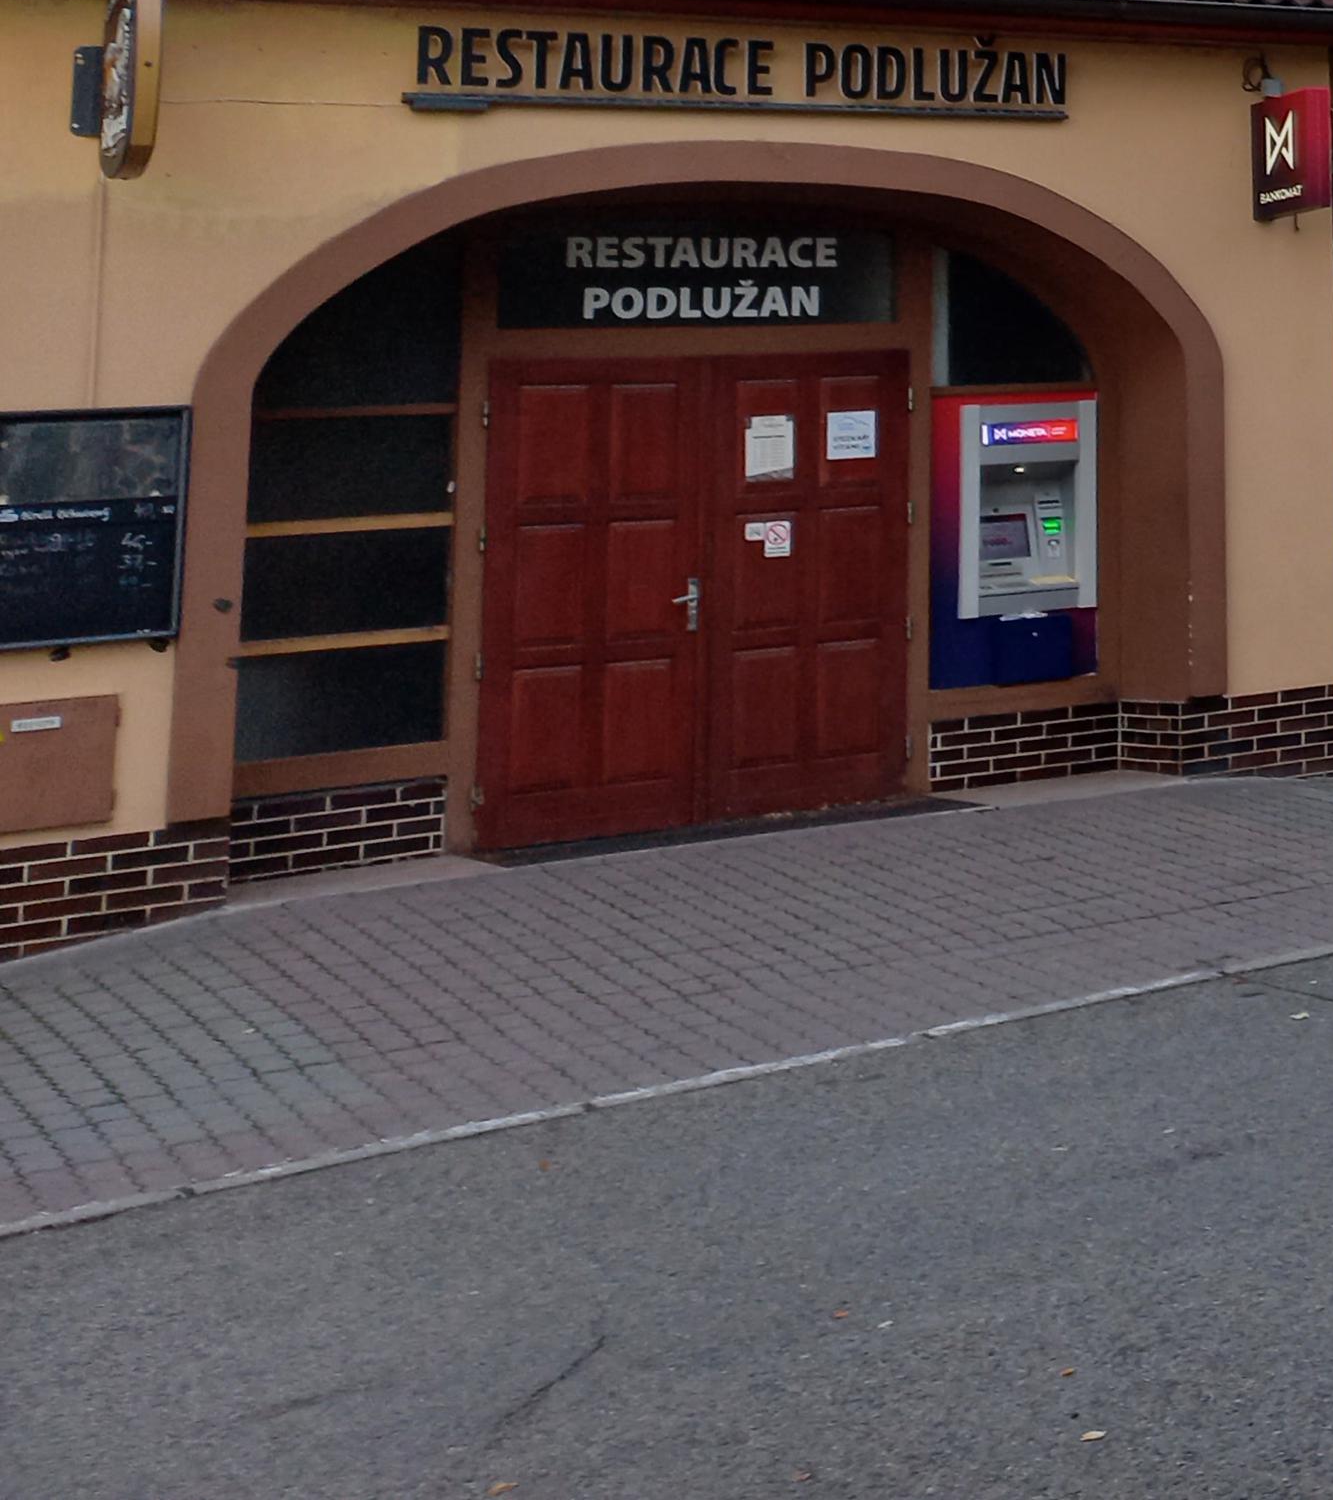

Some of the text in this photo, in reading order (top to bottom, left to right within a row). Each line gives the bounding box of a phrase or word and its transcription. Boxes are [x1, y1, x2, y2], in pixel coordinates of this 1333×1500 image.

[416, 25, 1067, 105] RESTAURACE PODLUŽAN
[1260, 184, 1303, 204] BANKOMAT
[566, 236, 839, 269] RESTAURACE
[583, 279, 820, 320] PODLUŽAN
[1007, 427, 1048, 438] MONETA
